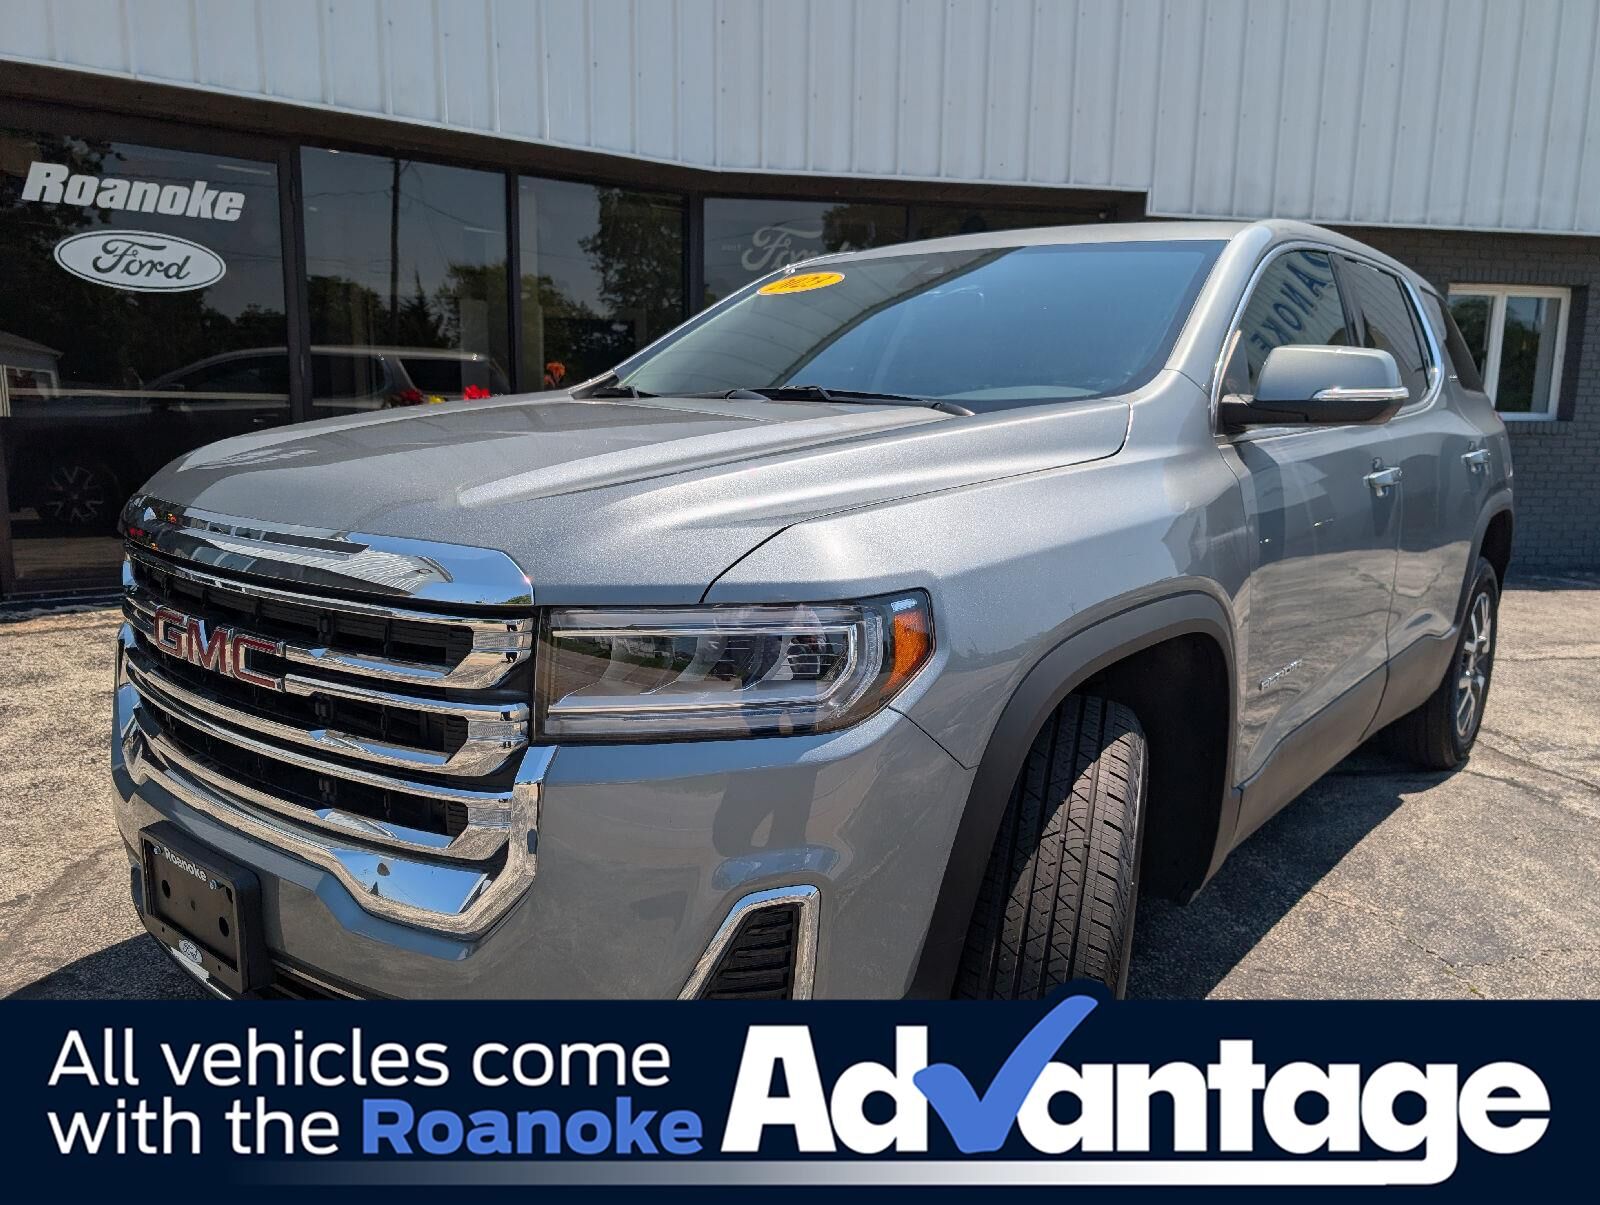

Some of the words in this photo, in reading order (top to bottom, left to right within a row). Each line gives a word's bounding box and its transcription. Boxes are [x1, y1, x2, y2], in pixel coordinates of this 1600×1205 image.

[21, 161, 246, 222] Roanoke
[92, 238, 191, 280] Ford
[154, 604, 286, 693] GMC
[163, 847, 208, 883] Roanoke
